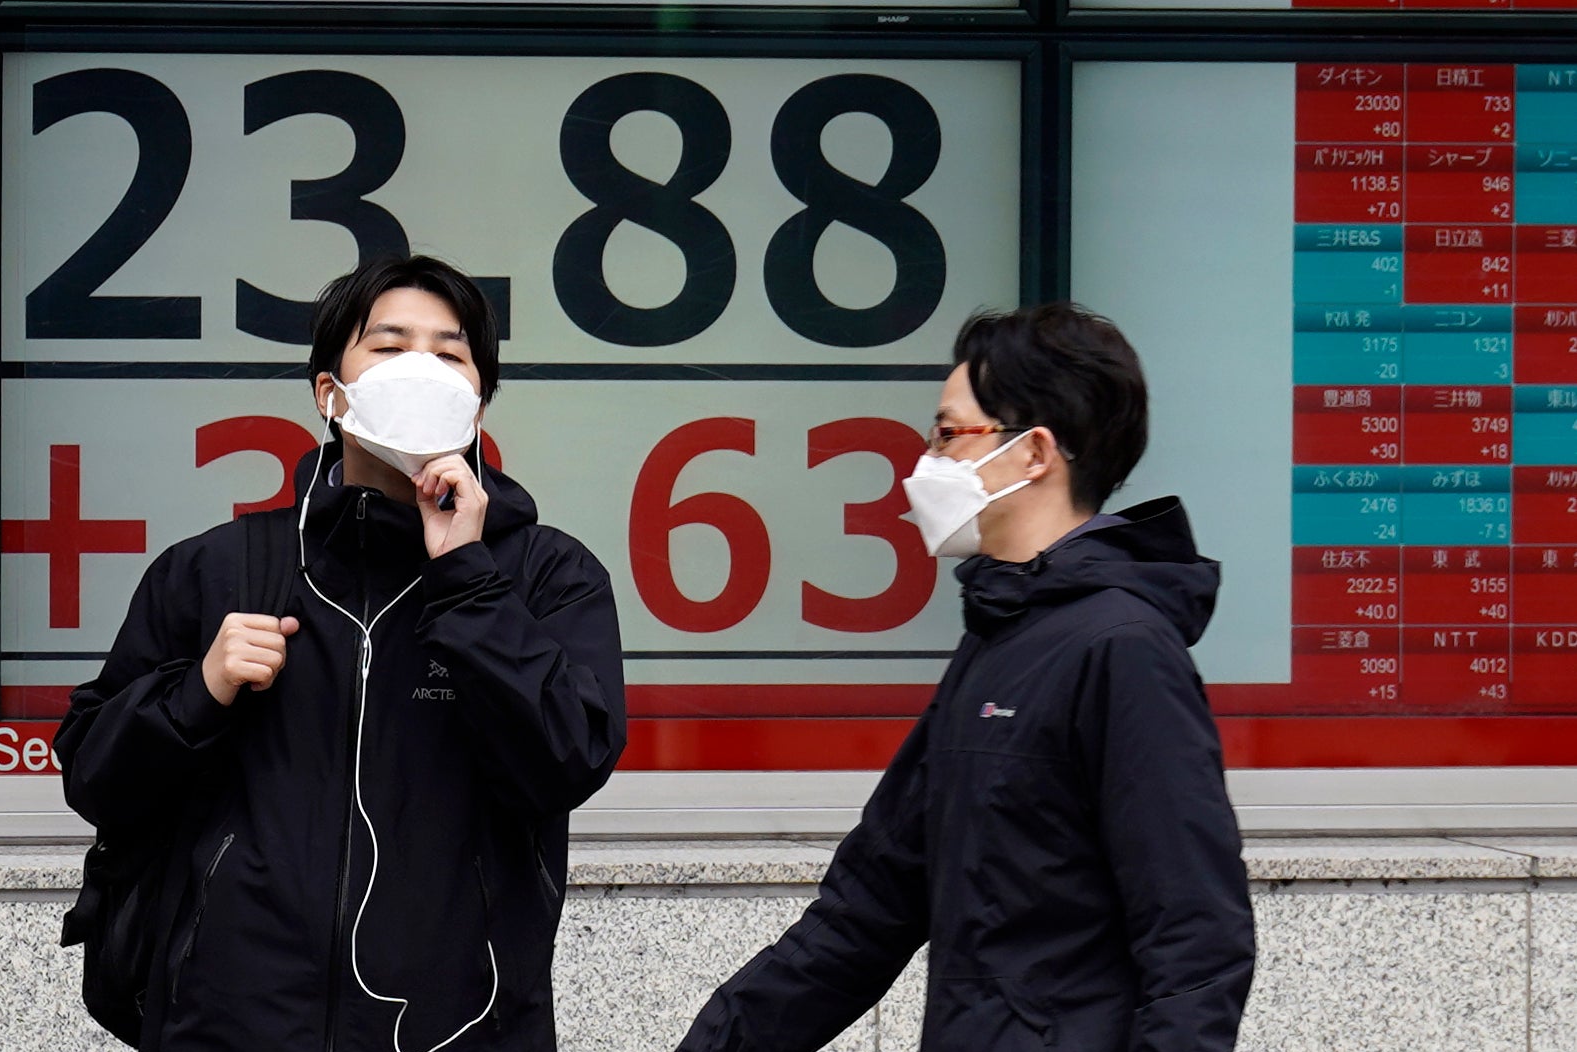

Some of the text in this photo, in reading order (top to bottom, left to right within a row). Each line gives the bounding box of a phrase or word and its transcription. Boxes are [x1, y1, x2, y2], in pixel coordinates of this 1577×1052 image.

[1318, 67, 1382, 85] ダイキン
[1356, 95, 1400, 110] 23030
[1484, 96, 1511, 112] 733
[1374, 122, 1400, 137] +80
[1493, 122, 1511, 138] +2
[1351, 176, 1400, 191] 1138.5
[1483, 176, 1510, 191] 946
[1368, 202, 1400, 217] +7.0
[1491, 202, 1510, 218] +2
[1372, 257, 1398, 272] 402
[1482, 257, 1509, 272] 842
[1384, 284, 1398, 297] -1
[1482, 283, 1508, 297] +11
[1435, 312, 1481, 326] ニコン
[1363, 337, 1397, 352] 3175
[1474, 337, 1506, 353] 1321
[1375, 363, 1398, 378] -20
[1494, 363, 1508, 379] -3
[1435, 389, 1482, 407] 三井物
[1362, 417, 1398, 432] 5300
[1472, 417, 1509, 432] 3749
[1370, 443, 1398, 459] +30
[1481, 443, 1508, 459] +18
[1314, 471, 1378, 487] ふくおか
[1433, 470, 1480, 487] みずほ
[1361, 498, 1397, 513] 2476
[1373, 524, 1396, 539] -24
[1322, 551, 1369, 568] 住友不
[1347, 578, 1396, 593] 2922.5
[1471, 578, 1507, 593] 3155
[1356, 604, 1397, 619] +40.0
[1479, 604, 1507, 619] +40
[1361, 658, 1396, 673] 3090
[1470, 658, 1506, 673] 4012
[1369, 684, 1396, 699] +15
[1479, 684, 1506, 699] +43
